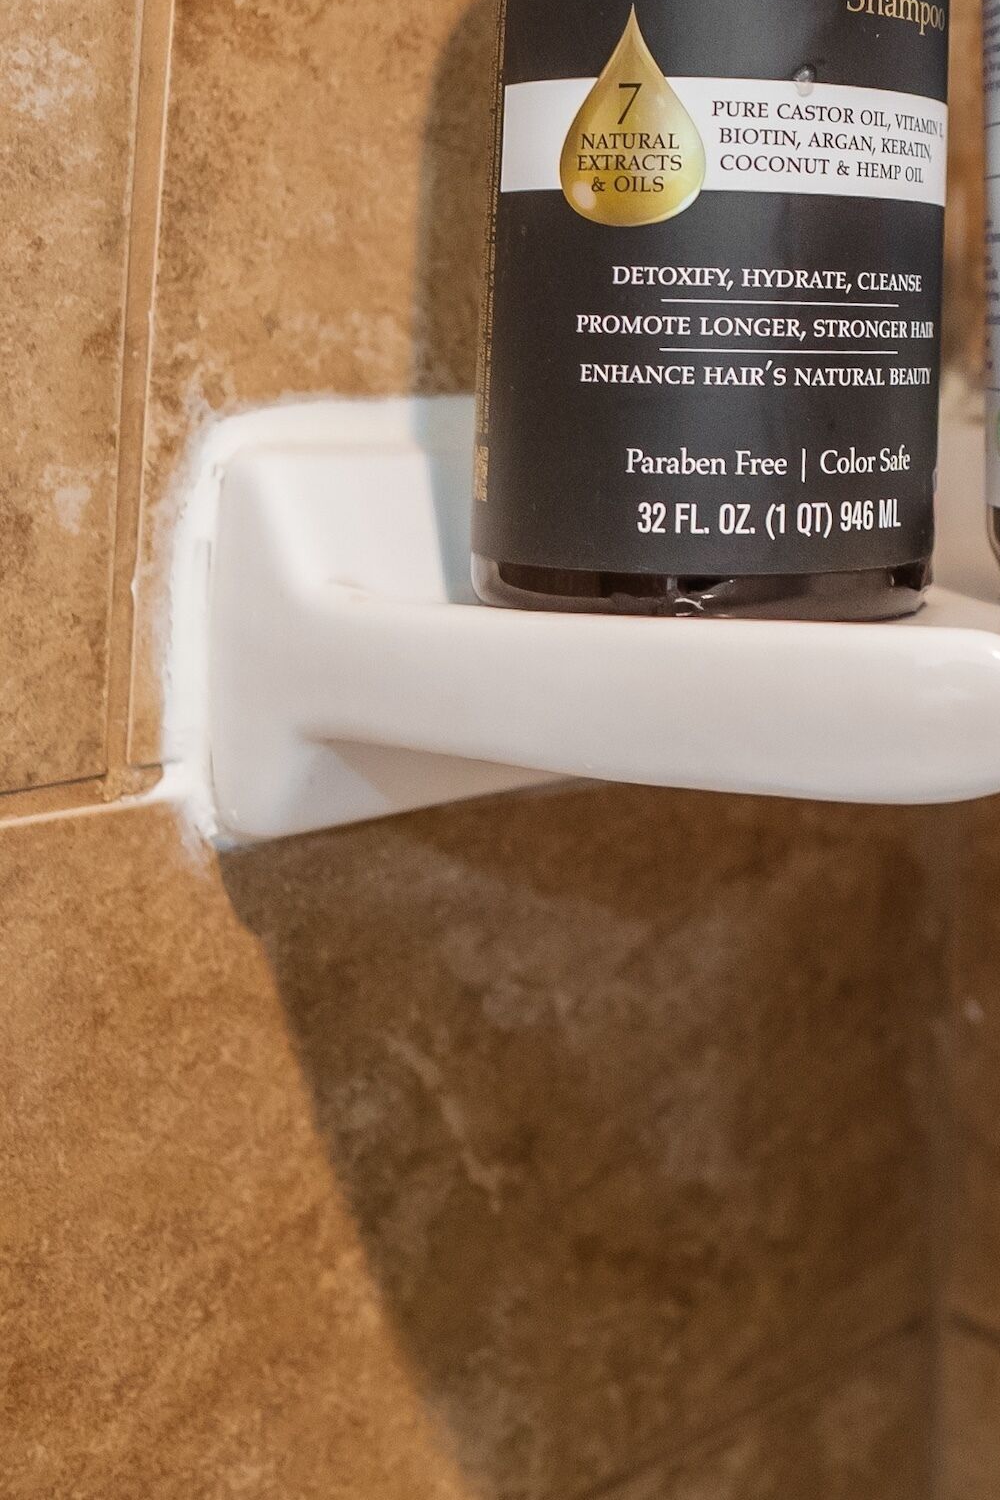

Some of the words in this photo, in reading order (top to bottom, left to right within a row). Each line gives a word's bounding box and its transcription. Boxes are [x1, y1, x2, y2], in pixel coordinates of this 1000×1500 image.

[617, 83, 642, 125] 7
[712, 101, 768, 118] PURE
[777, 103, 854, 124] CASTOR
[860, 109, 892, 131] OIL,
[895, 113, 938, 135] VITAMIN
[581, 133, 680, 150] NATURAL
[719, 127, 801, 149] BIOTIN,
[808, 132, 876, 155] ARGAN,
[577, 155, 682, 171] EXTRACTS
[720, 154, 830, 175] COCONUT
[836, 160, 850, 176] &
[856, 161, 901, 181] HEMP
[905, 166, 924, 183] OIL
[591, 177, 606, 192] &
[614, 176, 664, 192] OILS
[612, 266, 734, 292] DETOXIFY,
[741, 268, 852, 294] HYDRATE,
[857, 272, 922, 292] CLEANSE
[576, 314, 691, 336] PROMOTE
[699, 316, 806, 341] LONGER,
[813, 319, 907, 339] STRONGER
[910, 321, 934, 338] HAIR
[579, 363, 695, 385] ENHANCE
[702, 360, 787, 386] HAIR'S
[793, 367, 885, 386] NATURAL
[889, 367, 932, 385] BEAUTY
[625, 447, 727, 476] Paraben
[734, 449, 788, 476] Free
[820, 447, 876, 475] Color
[879, 444, 911, 472] Safe
[636, 502, 666, 534] 32
[674, 502, 710, 535] FL.
[718, 503, 756, 535] OZ.
[765, 502, 786, 540] (1
[796, 501, 833, 539] QT)
[839, 500, 874, 532] 946
[878, 498, 901, 528] ML
